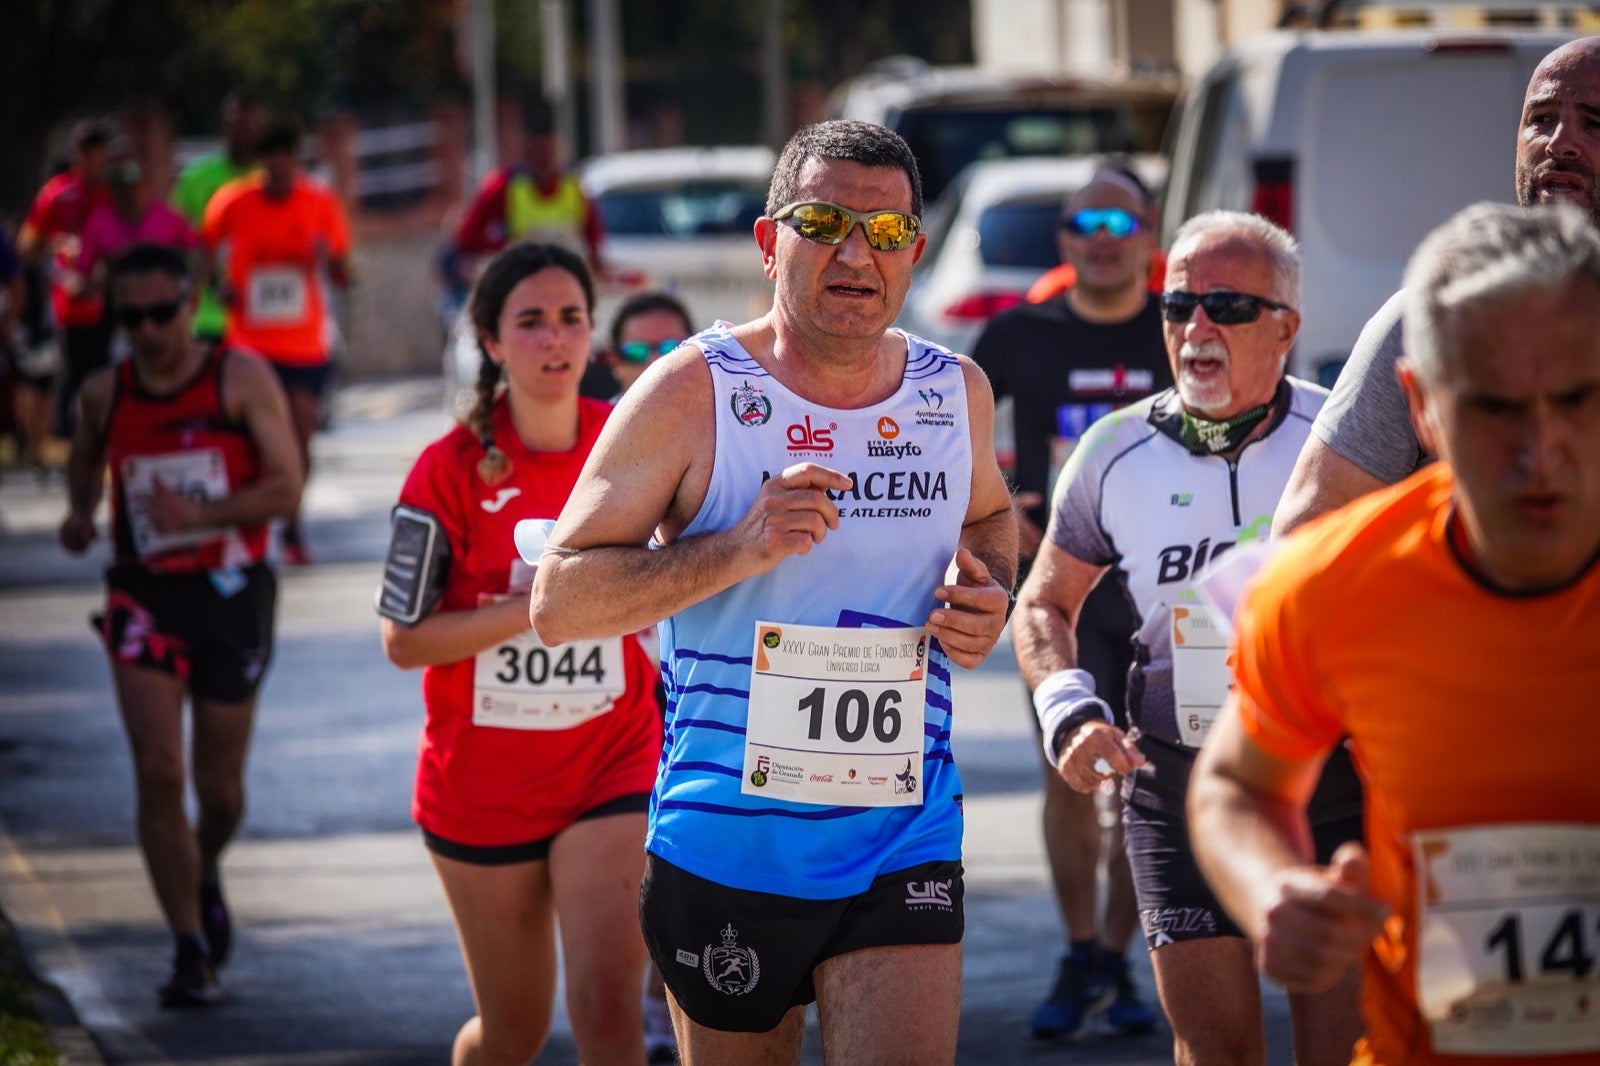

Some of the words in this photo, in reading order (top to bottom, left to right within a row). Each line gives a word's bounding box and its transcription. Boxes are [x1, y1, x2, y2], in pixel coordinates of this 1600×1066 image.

[868, 441, 922, 460] mayfo
[762, 470, 948, 501] ACENA
[851, 508, 932, 518] ATLETISMO
[782, 639, 806, 657] XXXV
[496, 645, 605, 685] 3044
[798, 687, 902, 743] 106
[1485, 908, 1600, 985] 14
